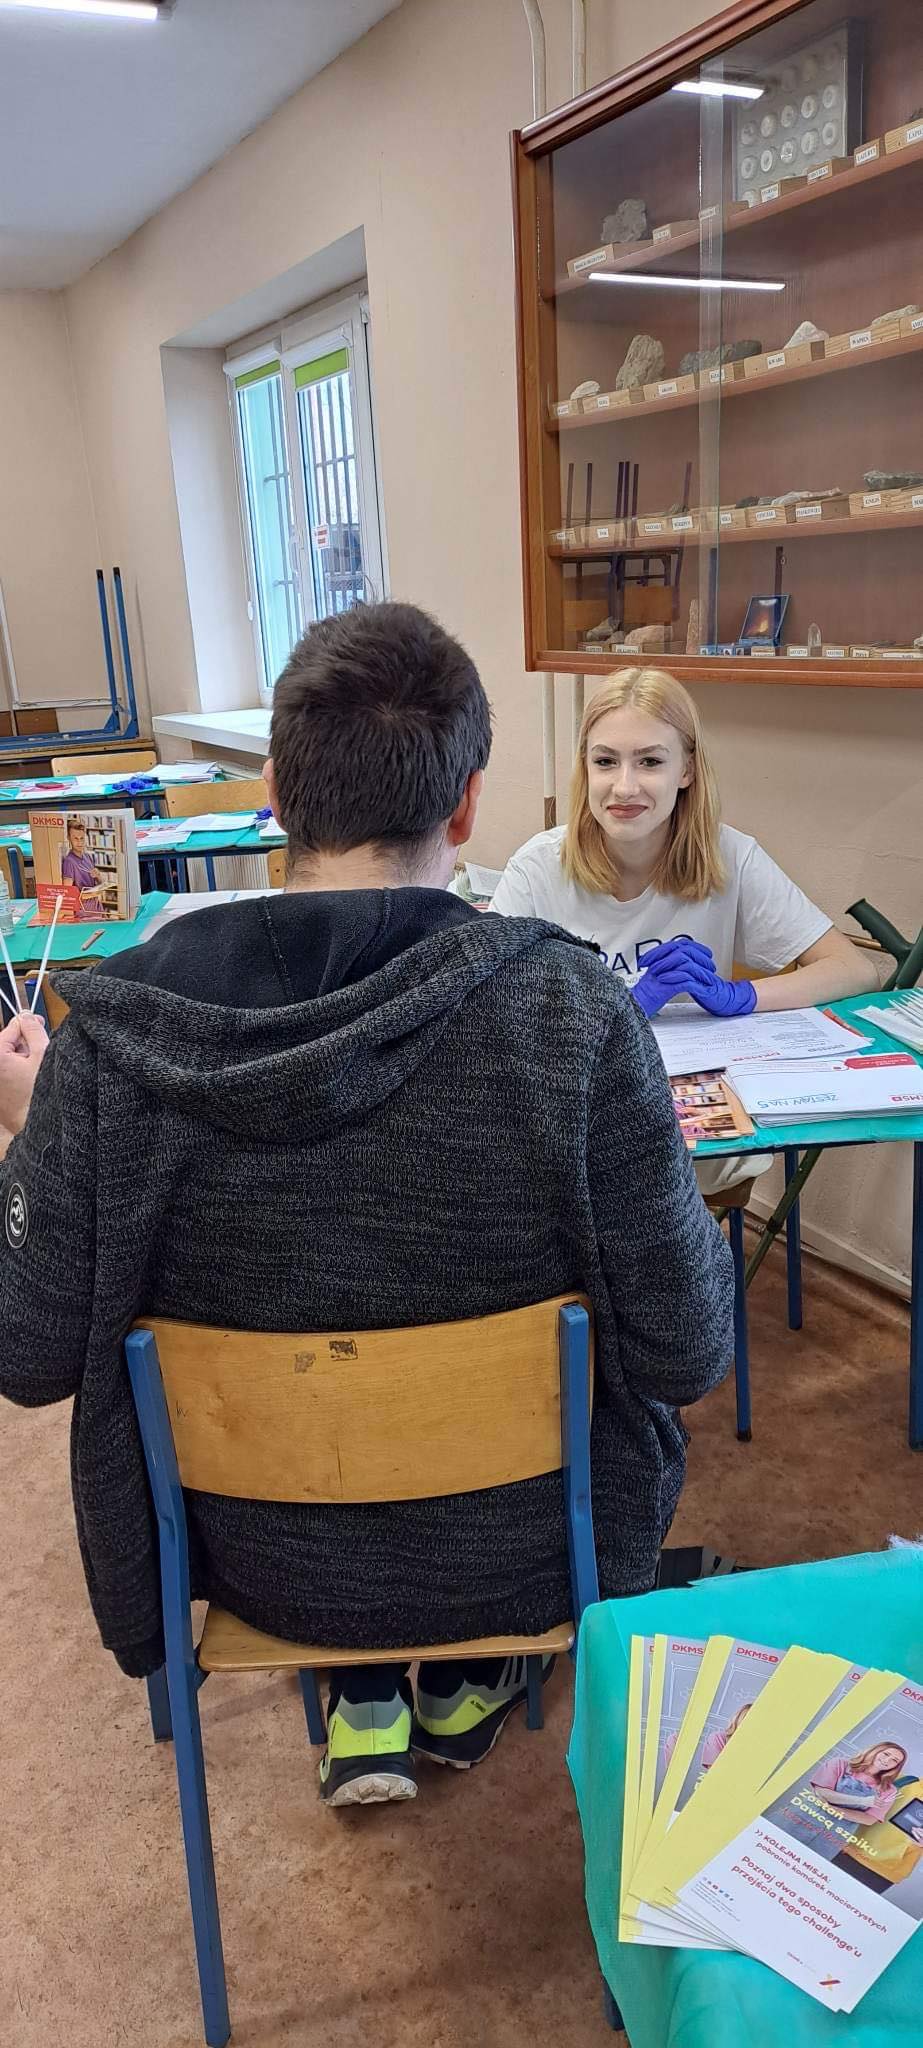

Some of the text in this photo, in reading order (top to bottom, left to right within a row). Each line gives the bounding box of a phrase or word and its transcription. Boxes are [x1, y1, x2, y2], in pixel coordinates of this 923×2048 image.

[32, 817, 56, 826] DKMS
[671, 1643, 704, 1655] DKMS
[736, 1647, 769, 1661] DKMS
[799, 1788, 845, 1820] Zostań
[790, 1796, 835, 1830] Dawcą
[835, 1826, 878, 1857] szpiku
[763, 1835, 801, 1864] KOLEJNA
[741, 1855, 841, 1929] Poznaj dwa sposoby
[756, 1842, 888, 1934] pobranie komórek macierzystych
[730, 1865, 777, 1899] przejścia
[778, 1896, 802, 1917] tego
[802, 1914, 863, 1958] challenge'u
